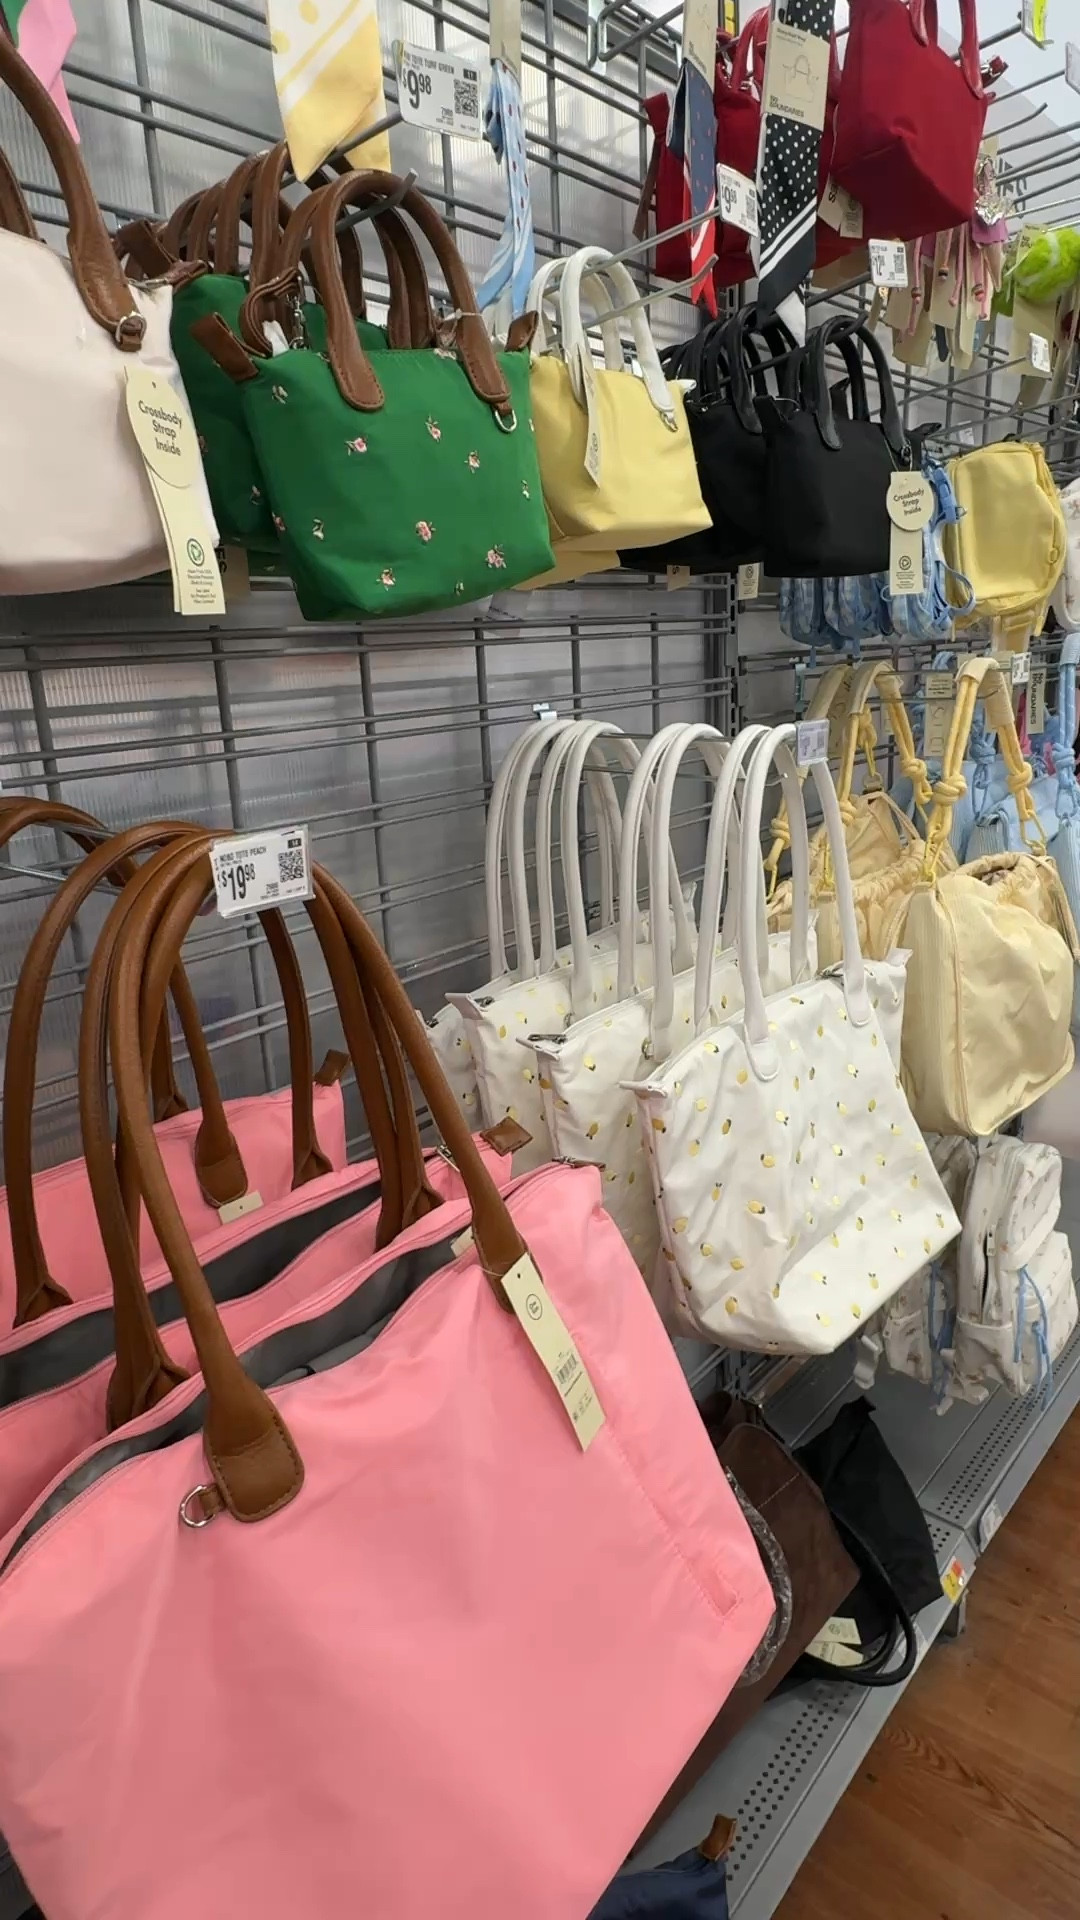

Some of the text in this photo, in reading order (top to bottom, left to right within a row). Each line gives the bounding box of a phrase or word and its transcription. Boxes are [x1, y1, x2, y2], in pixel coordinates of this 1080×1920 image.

[138, 400, 182, 429] Crossbody
[152, 420, 176, 440] Strap
[155, 437, 181, 456] Inside
[893, 488, 924, 501] Crossbody
[250, 846, 267, 856] PEACH
